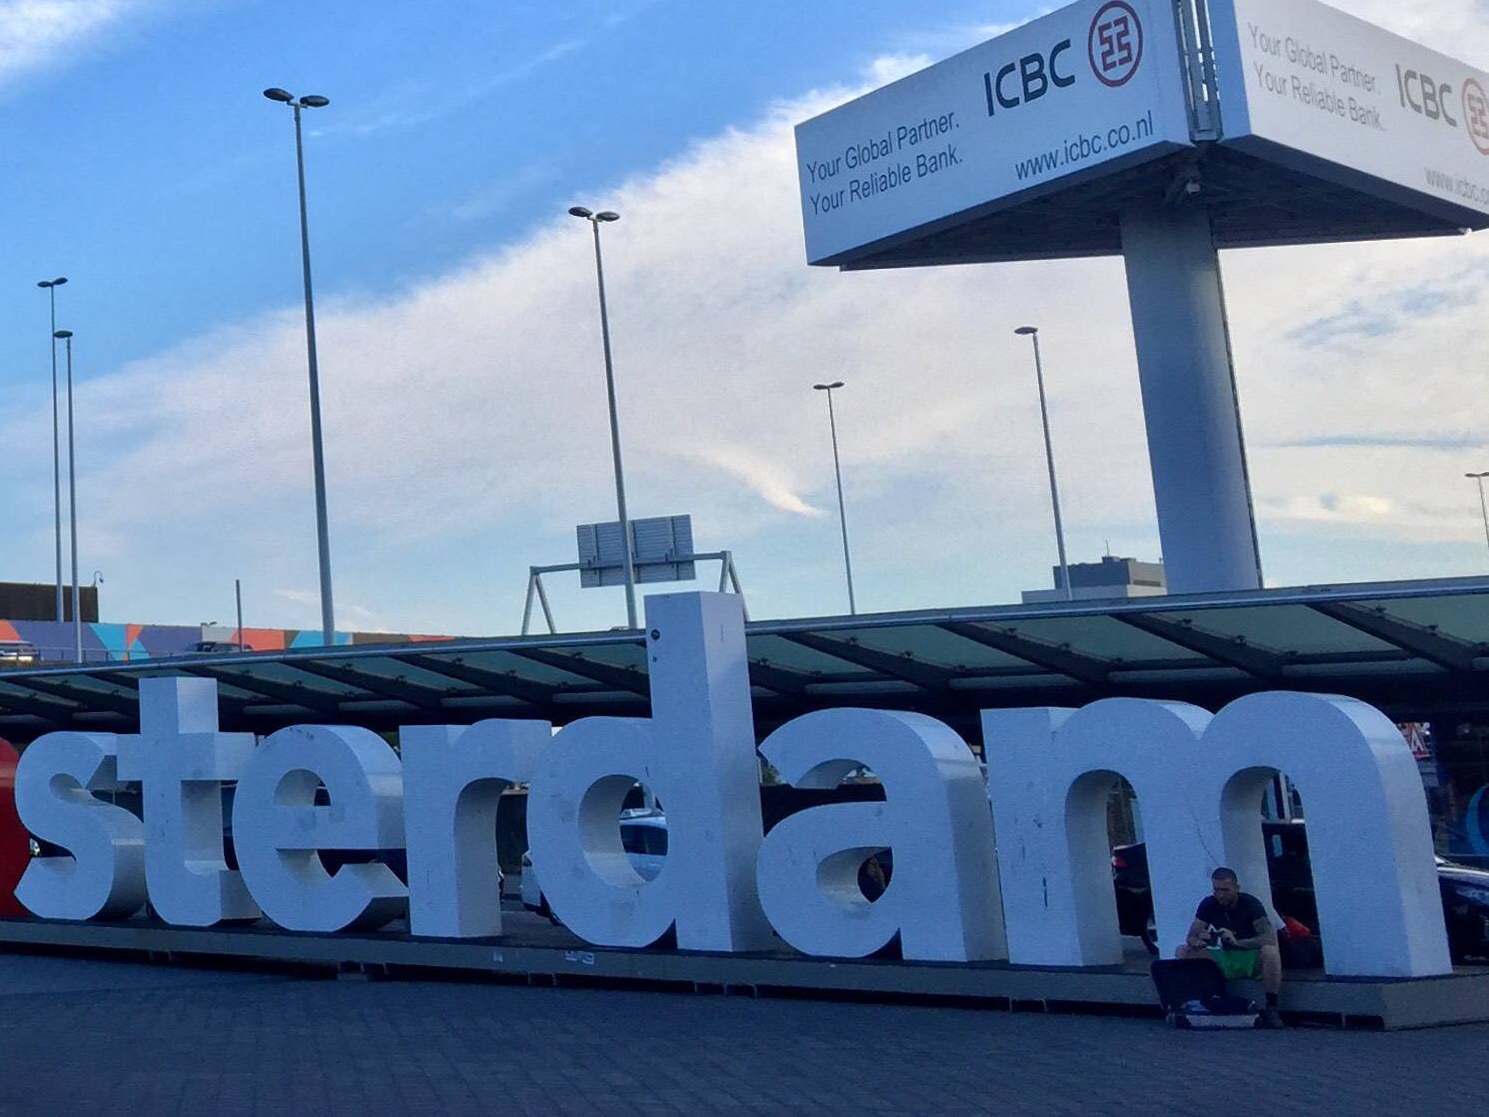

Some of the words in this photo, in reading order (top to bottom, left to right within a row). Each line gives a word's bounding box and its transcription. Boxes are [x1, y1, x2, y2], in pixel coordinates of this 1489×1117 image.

[983, 38, 1076, 117] ICBC
[1247, 21, 1281, 56] Your
[1285, 36, 1327, 75] Global
[1330, 55, 1381, 95] Partner.
[1253, 60, 1287, 96] Your
[1291, 75, 1345, 117] Reliable
[1396, 63, 1457, 127] ICBC
[806, 154, 841, 183] Your
[844, 128, 893, 169] Global
[897, 110, 960, 150] Partner.
[808, 186, 845, 216] Your
[849, 162, 912, 202] Reliable
[916, 142, 963, 178] Bank.
[1015, 109, 1154, 180] www.icbc.co.nl
